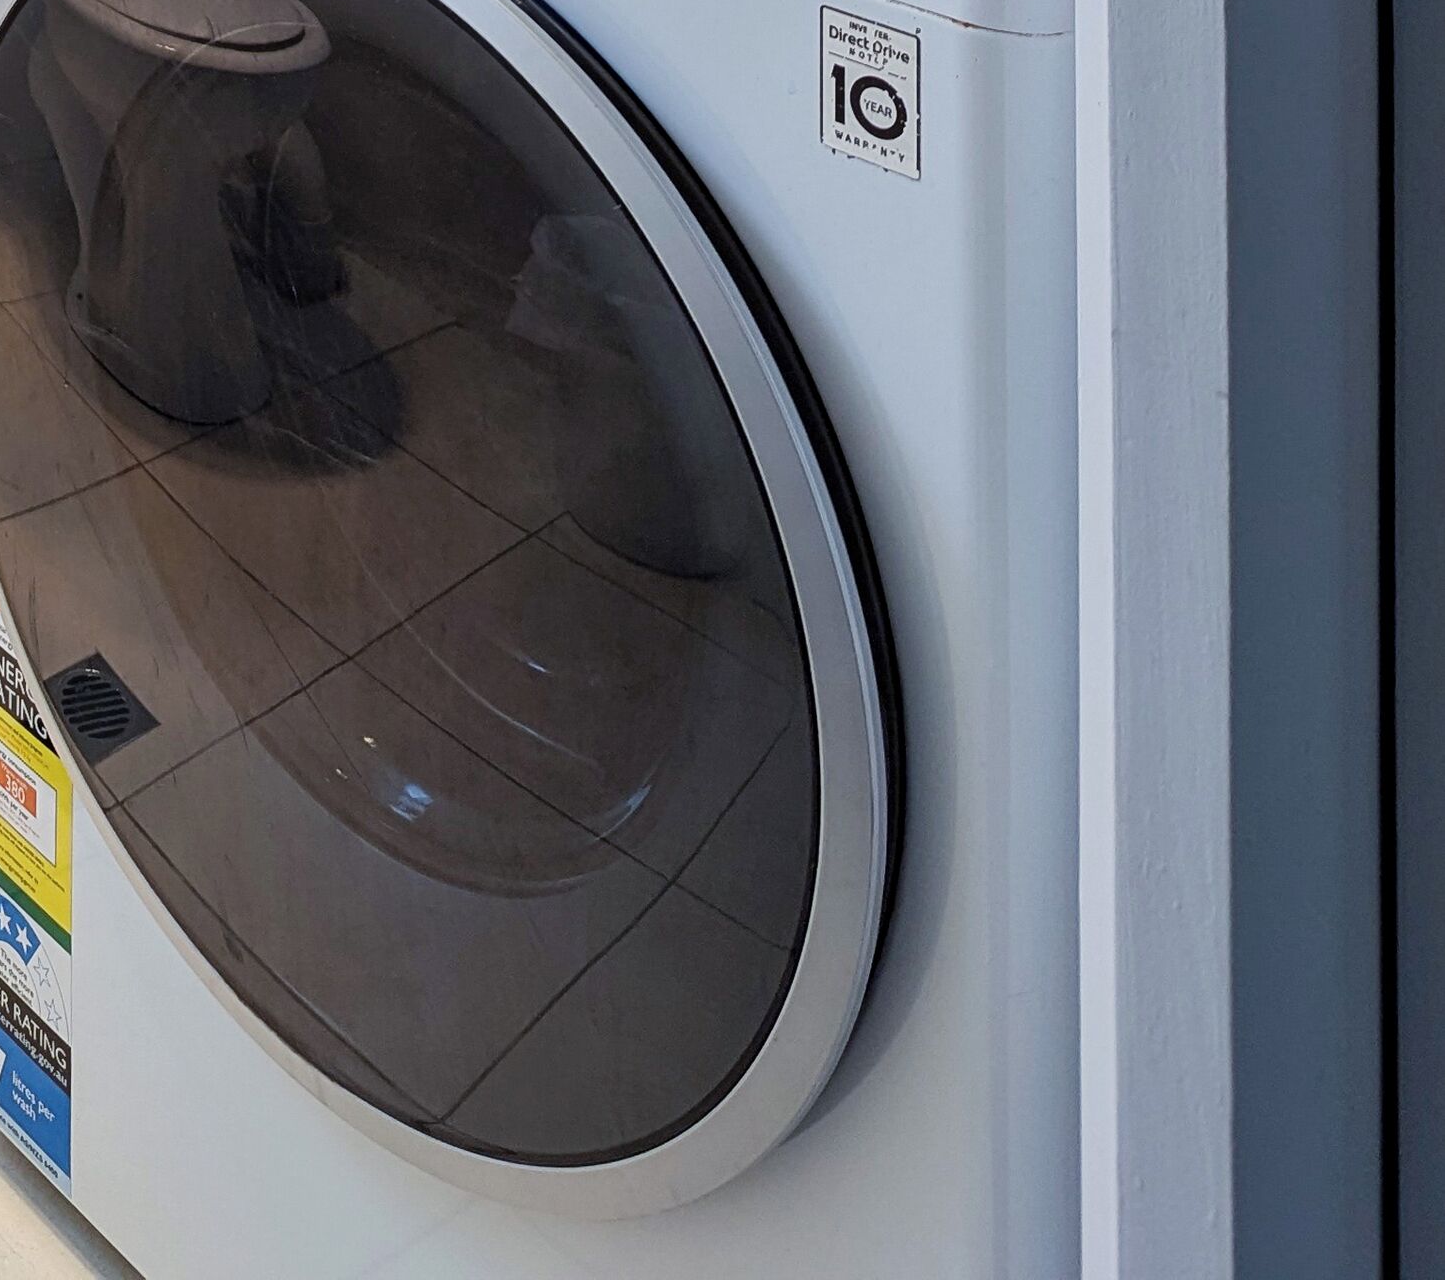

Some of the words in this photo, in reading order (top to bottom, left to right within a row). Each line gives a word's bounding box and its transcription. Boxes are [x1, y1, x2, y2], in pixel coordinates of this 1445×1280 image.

[829, 25, 870, 51] Direct
[872, 40, 911, 65] Drive
[830, 63, 908, 141] 10
[863, 98, 893, 119] YEAR
[5, 774, 26, 804] 380
[0, 948, 12, 965] The
[13, 963, 28, 981] more
[13, 1002, 67, 1070] RATING
[12, 1070, 36, 1105] litres
[38, 1100, 56, 1122] per
[12, 1090, 36, 1122] wash
[7, 1123, 20, 1139] with
